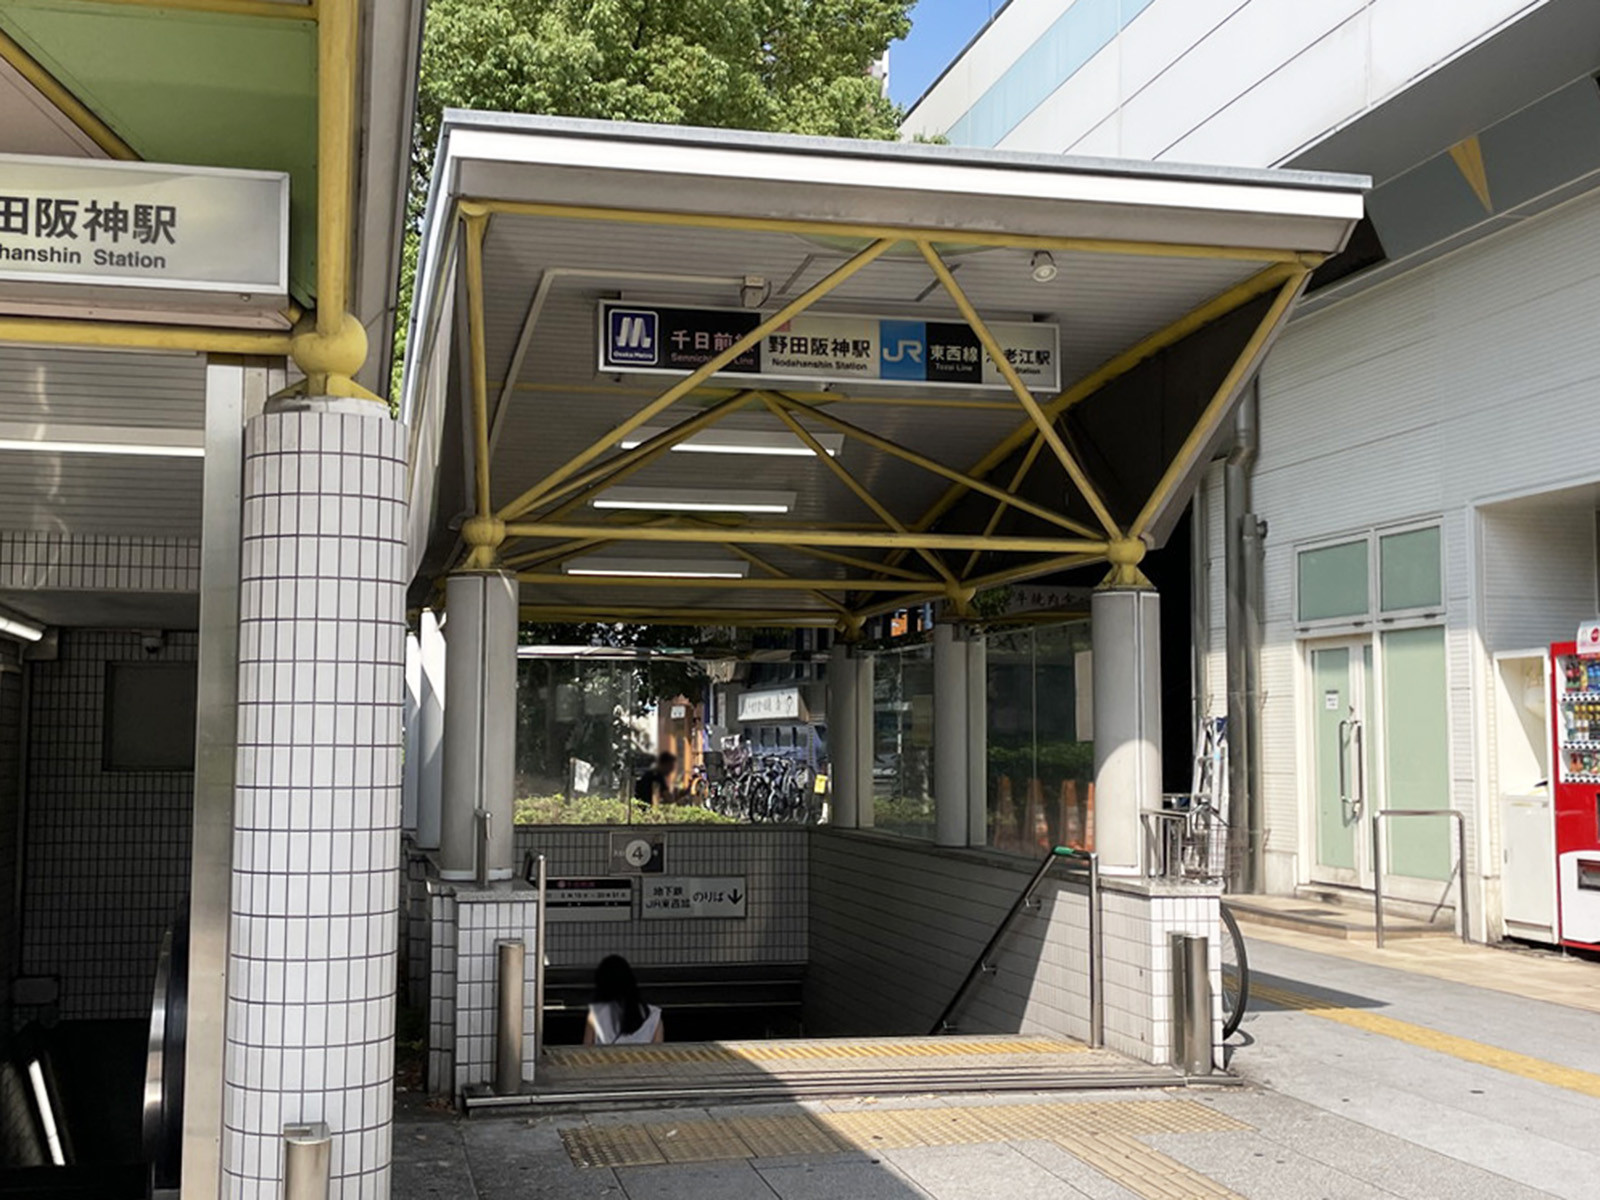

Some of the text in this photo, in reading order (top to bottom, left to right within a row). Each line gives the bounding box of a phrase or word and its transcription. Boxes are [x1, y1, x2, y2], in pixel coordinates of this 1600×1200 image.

[94, 249, 166, 268] Station
[670, 330, 754, 354] 千日前
[768, 335, 871, 358] 野田阪神駅
[883, 340, 923, 363] JR
[930, 344, 979, 363] 東西線
[772, 357, 868, 372] Nodahanshin Station
[936, 362, 973, 372] Tozai Line
[632, 846, 644, 860] 4
[653, 886, 683, 897] 地下鉄
[692, 891, 724, 903] のりば
